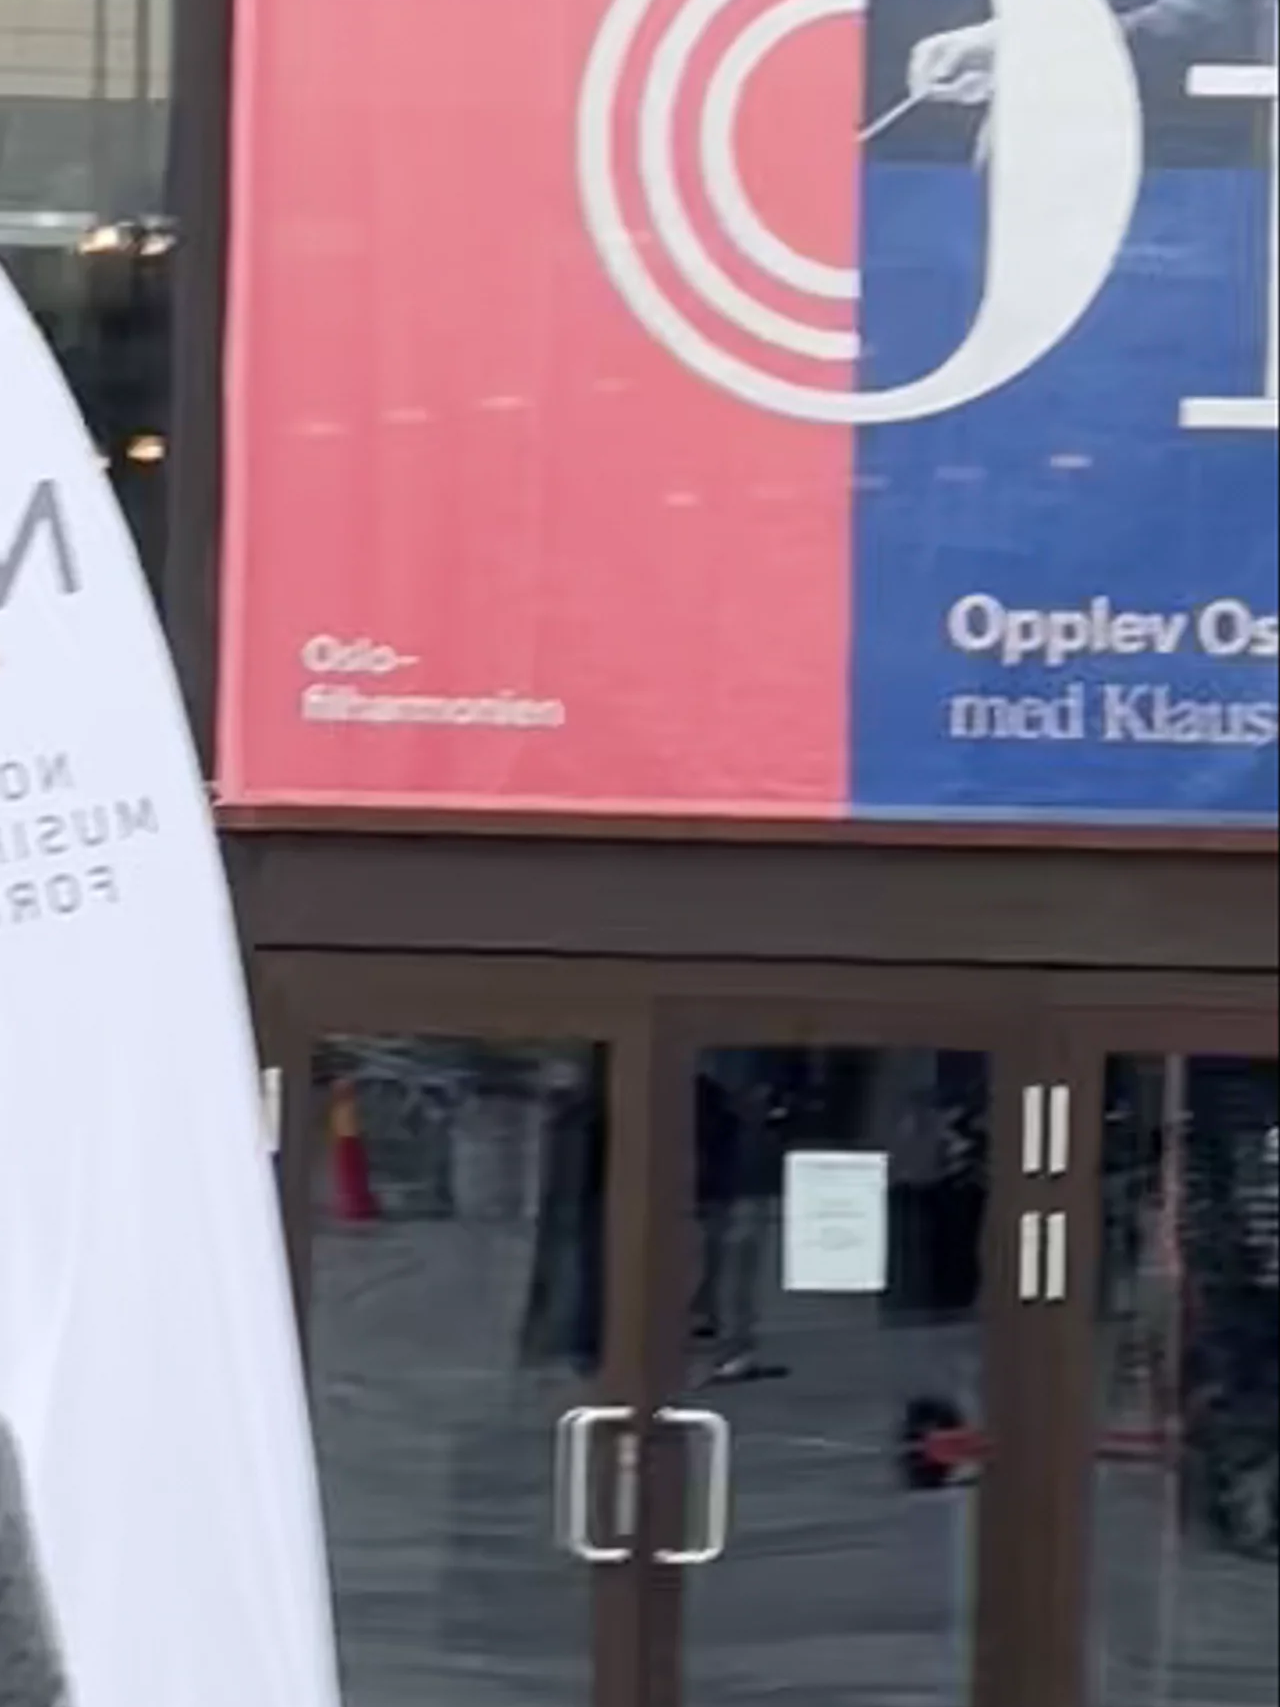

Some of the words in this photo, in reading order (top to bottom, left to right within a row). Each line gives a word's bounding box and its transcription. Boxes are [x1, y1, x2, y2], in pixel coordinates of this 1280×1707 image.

[300, 633, 421, 674] Oslo-
[947, 592, 1188, 667] Opplev
[949, 680, 1086, 740] med
[1101, 682, 1278, 746] Klaus
